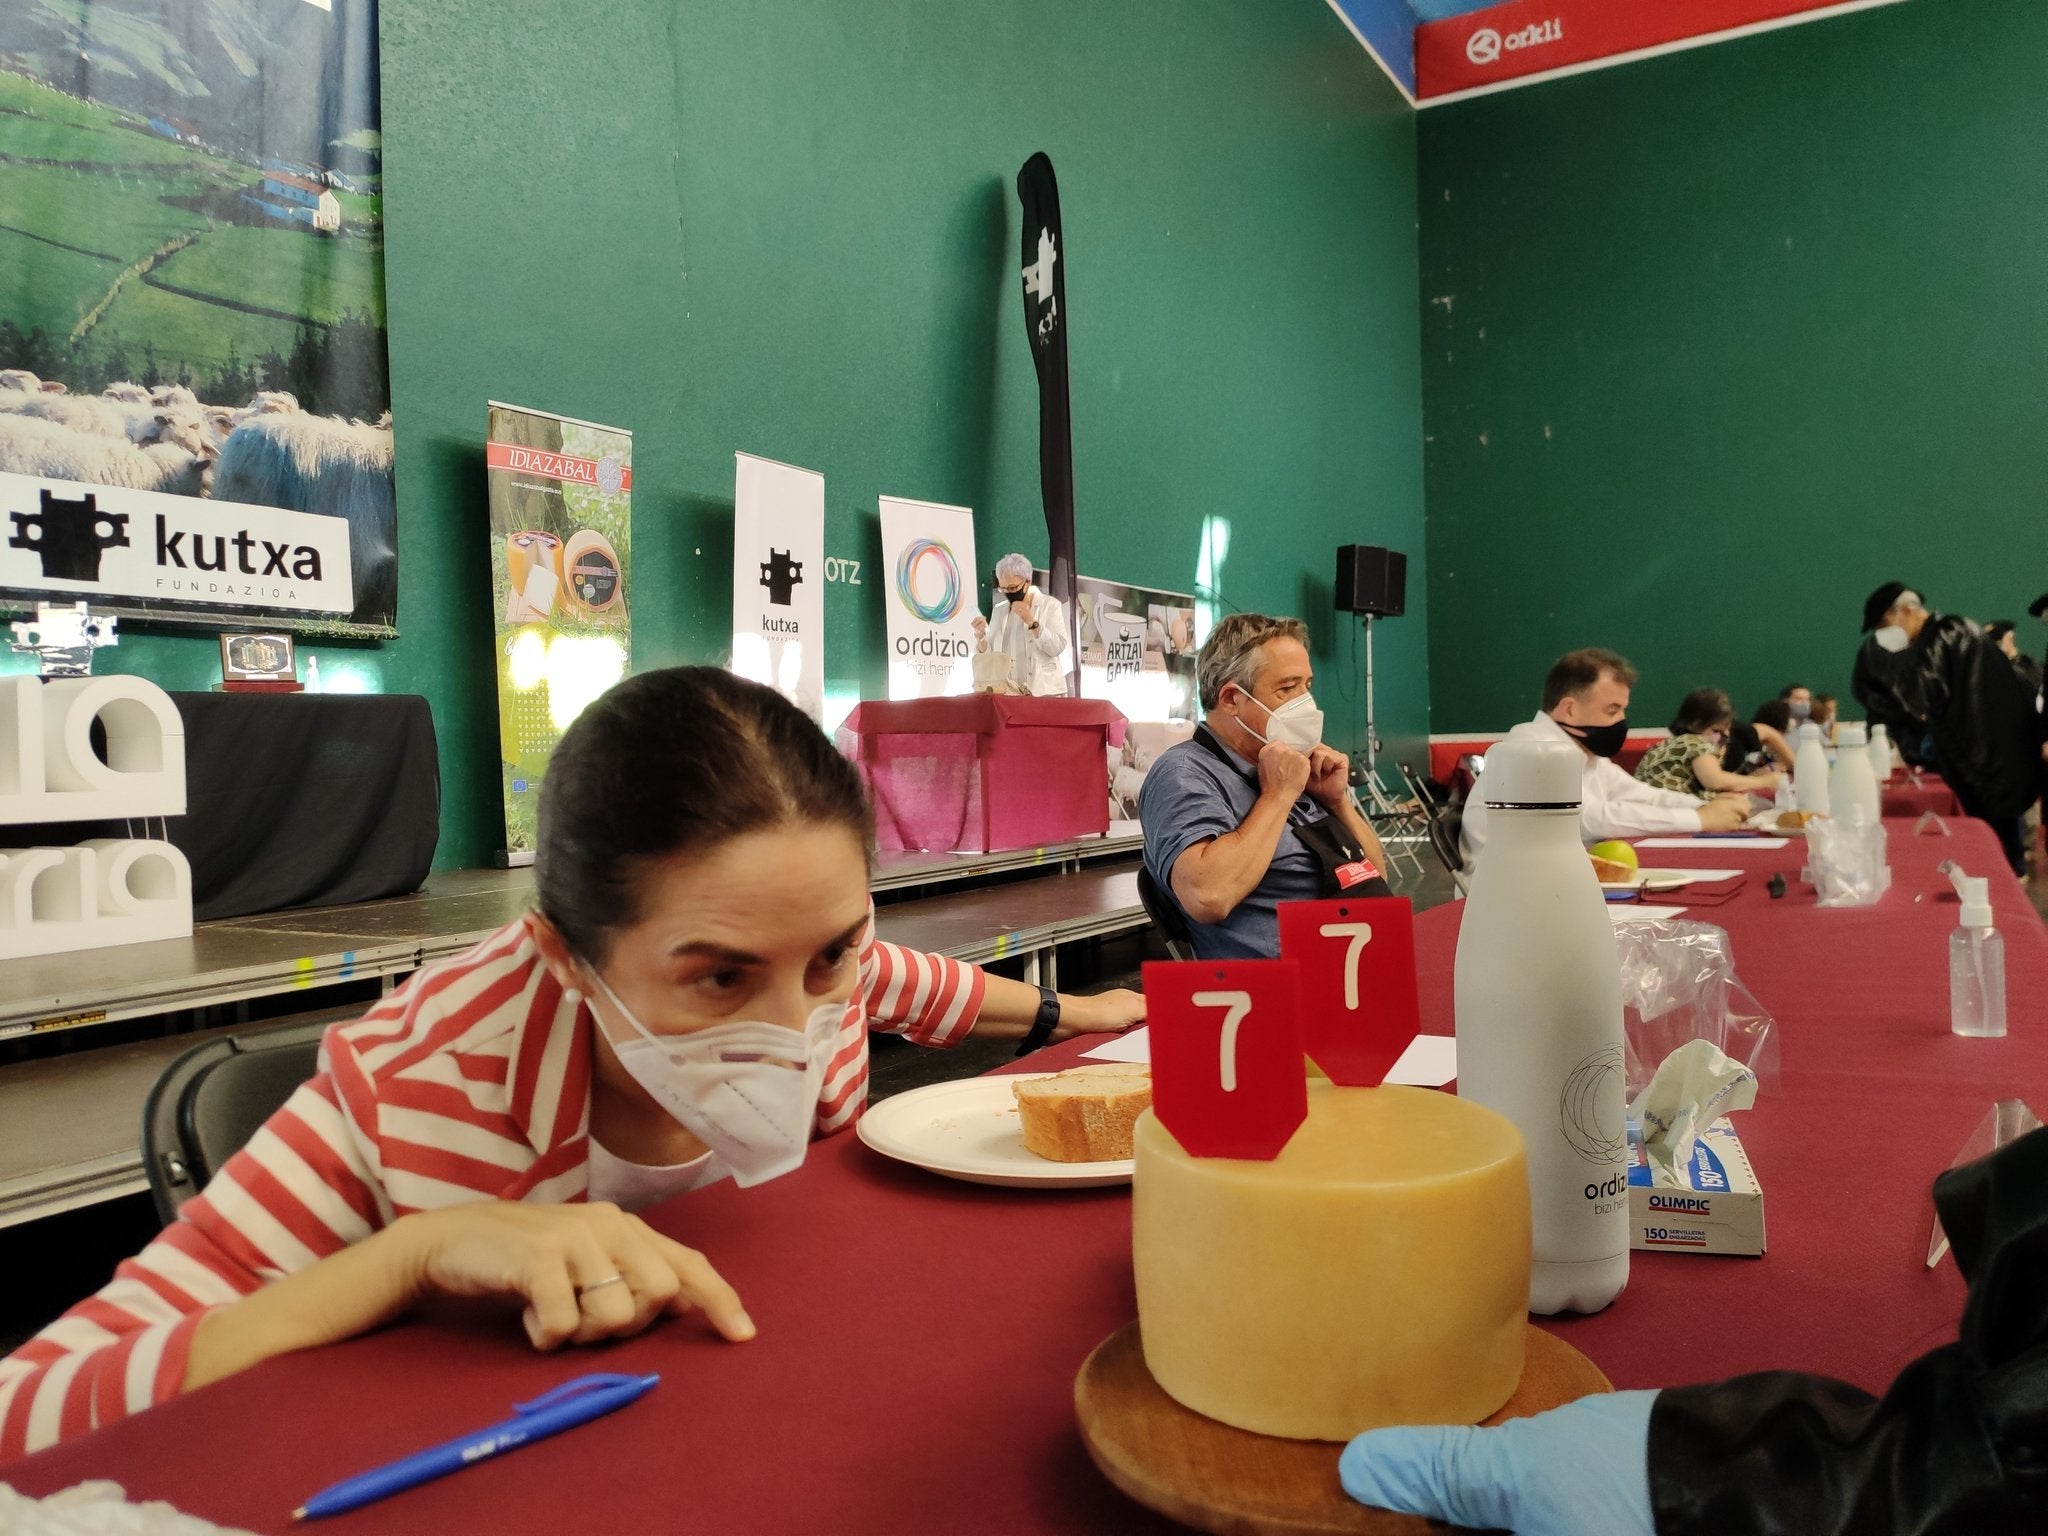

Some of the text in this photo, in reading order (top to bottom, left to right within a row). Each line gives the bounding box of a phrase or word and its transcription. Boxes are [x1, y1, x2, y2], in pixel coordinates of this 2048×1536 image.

[1504, 17, 1563, 51] orkli
[509, 449, 594, 480] IDIAZABAL
[156, 514, 322, 581] kutxa
[824, 556, 861, 585] OTZ
[156, 578, 296, 599] FUNDAZIOA
[763, 614, 799, 633] kutxa
[896, 629, 969, 658] ordizia
[1107, 642, 1142, 660] ARTZAI
[1319, 922, 1372, 1011] 7
[1191, 990, 1252, 1093] 7
[1698, 1170, 1725, 1188] 150
[1594, 1200, 1612, 1215] bizi
[1649, 1195, 1711, 1211] OLIMPIC
[1644, 1227, 1668, 1240] 150
